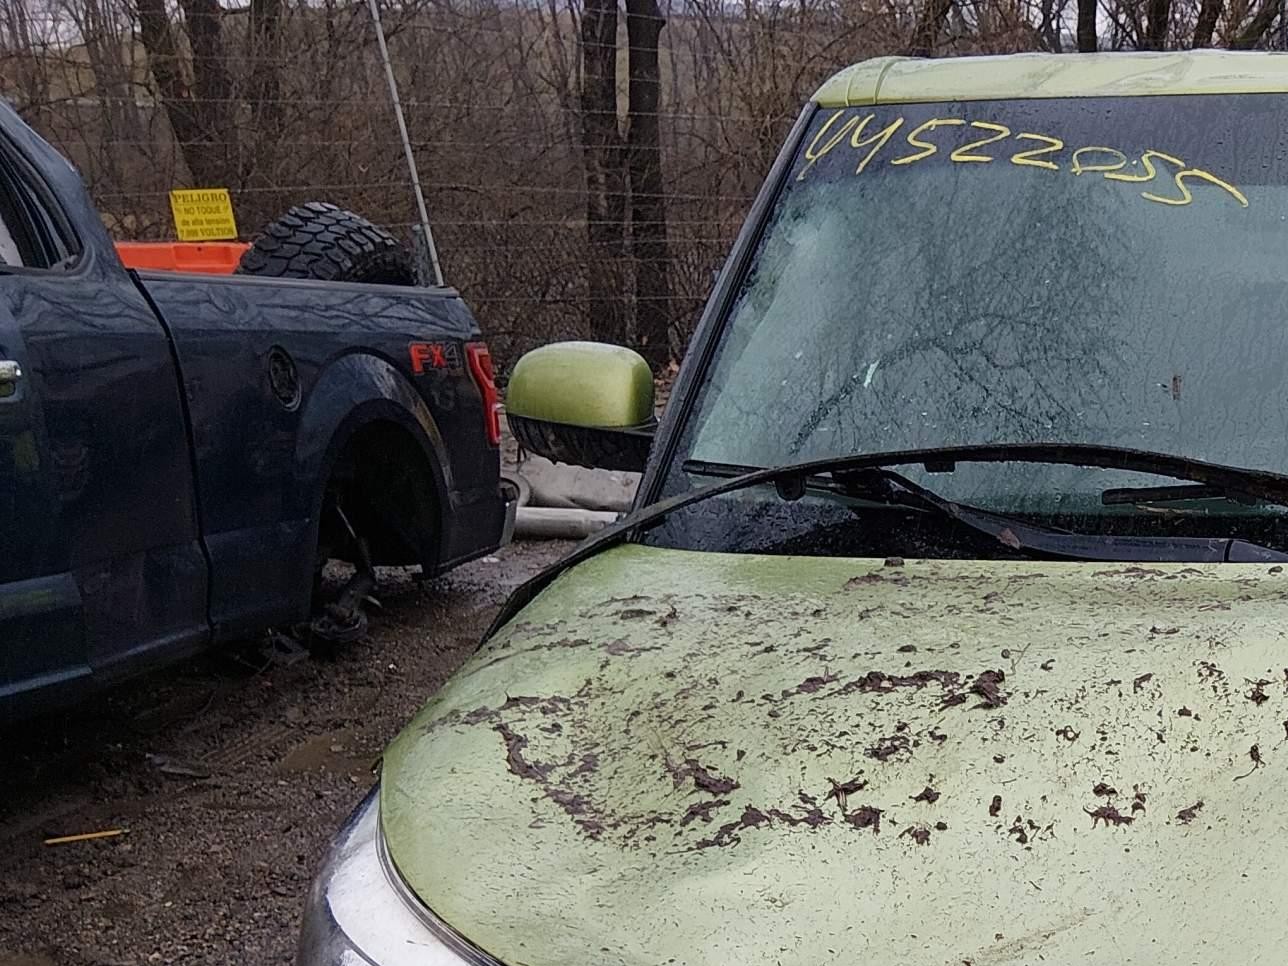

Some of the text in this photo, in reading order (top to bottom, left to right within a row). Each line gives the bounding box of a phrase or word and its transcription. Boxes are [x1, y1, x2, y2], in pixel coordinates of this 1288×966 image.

[798, 110, 1248, 207] 44522055
[174, 193, 228, 203] PELIGRO
[407, 341, 463, 375] FX4
